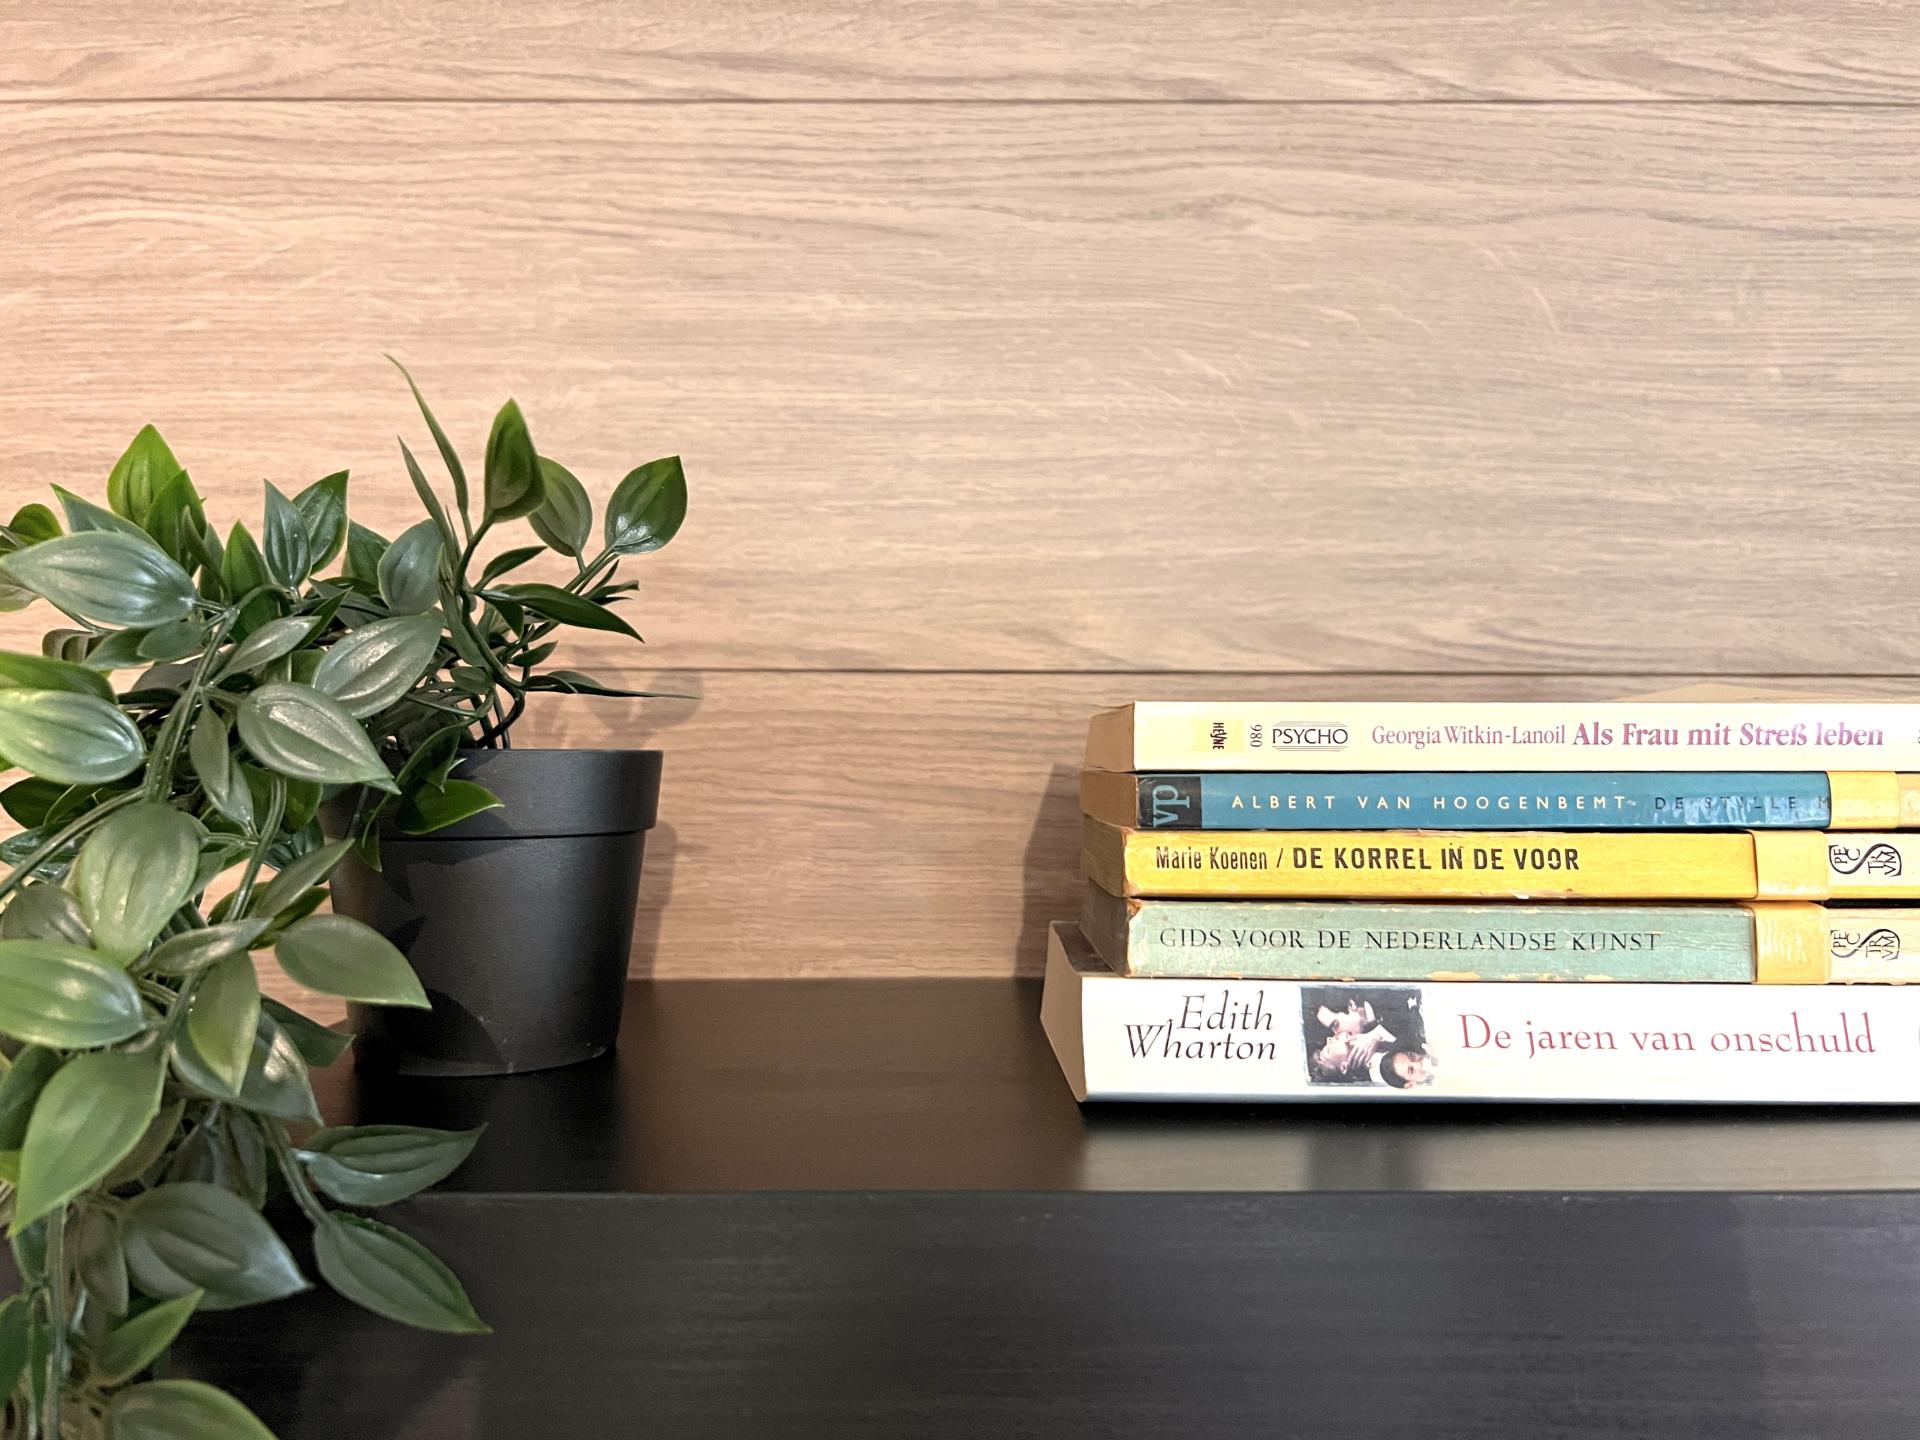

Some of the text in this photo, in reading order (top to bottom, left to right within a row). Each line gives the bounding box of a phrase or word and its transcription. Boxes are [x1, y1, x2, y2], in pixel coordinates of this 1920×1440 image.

[1210, 722, 1228, 750] HEYNE
[1272, 728, 1349, 745] PSYCHO
[1371, 724, 1566, 750] Georgia Witkin-Lanoil
[1572, 721, 1884, 747] Als Frau mit Streß leben
[1152, 784, 1191, 829] vp
[1231, 795, 1626, 810] ALBERT VAN HOOGENBEMT
[1654, 797, 1685, 810] DE
[1155, 846, 1202, 869] Marie
[1209, 846, 1268, 870] Koenen
[1293, 847, 1324, 869] DE
[1334, 847, 1432, 870] KORREL
[1440, 847, 1464, 870] IN
[1473, 848, 1505, 870] DE
[1513, 848, 1580, 871] VOOR
[1159, 928, 1665, 951] GIDS VOOR DE NEDERLANDSE KUNST
[1176, 989, 1274, 1031] Edith
[1124, 1018, 1277, 1060] Wharton
[1457, 1011, 1877, 1059] De jaren van onschuld
